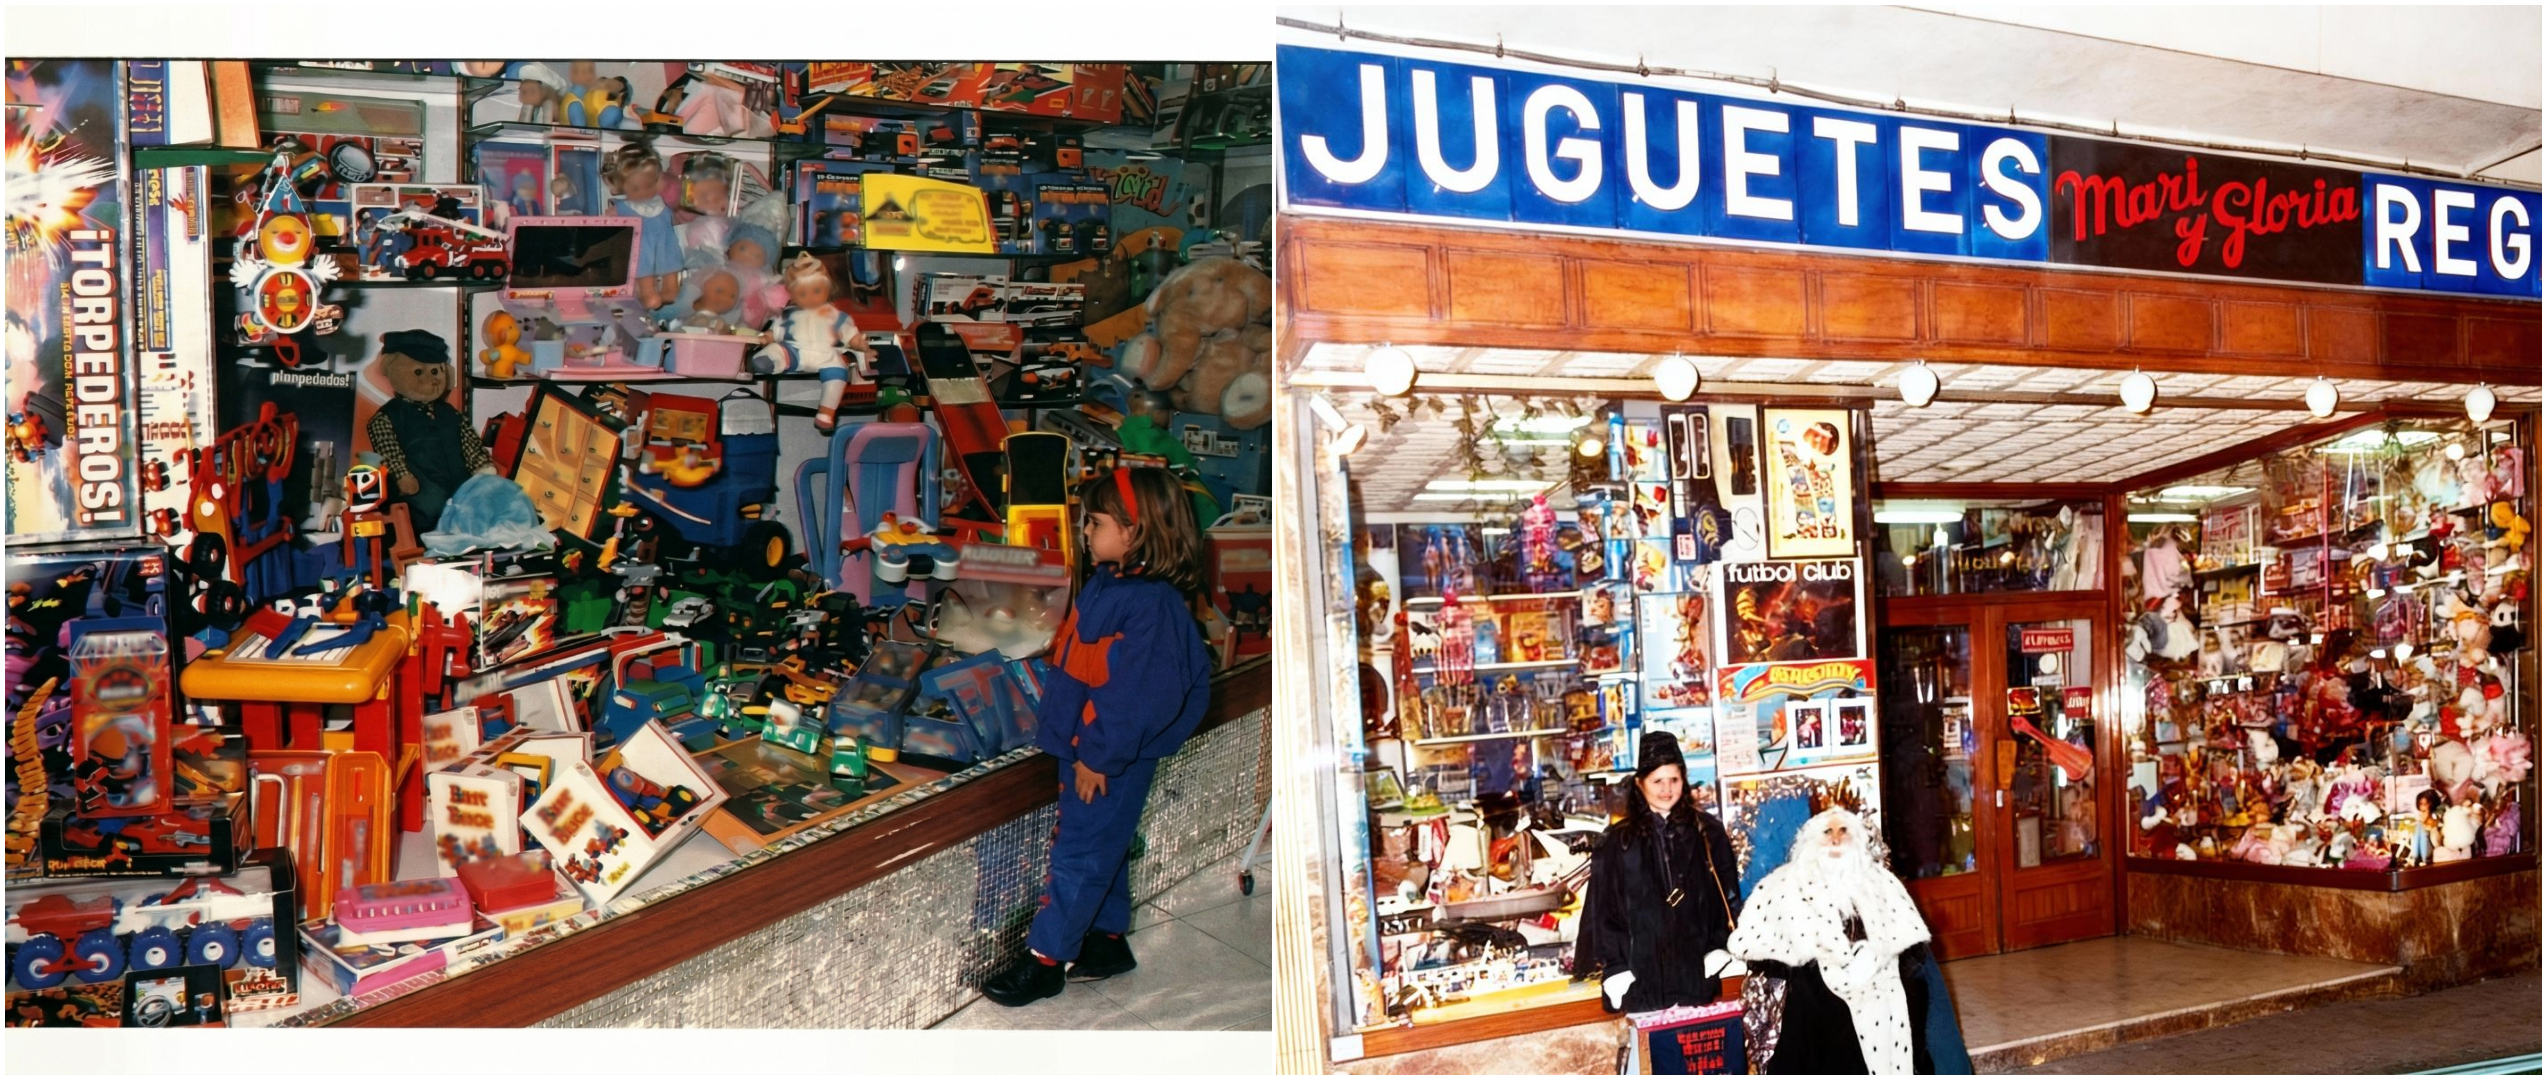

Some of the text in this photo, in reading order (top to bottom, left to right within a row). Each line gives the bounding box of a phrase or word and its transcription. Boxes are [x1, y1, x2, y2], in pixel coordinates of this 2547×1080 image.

[1301, 63, 2042, 241] JUGUETES
[2055, 157, 2208, 242] Mari
[2175, 213, 2208, 268] y
[2212, 177, 2361, 269] Gloria
[70, 228, 124, 526] ¡TORPEDEROS!
[1728, 560, 1851, 583] futbol club
